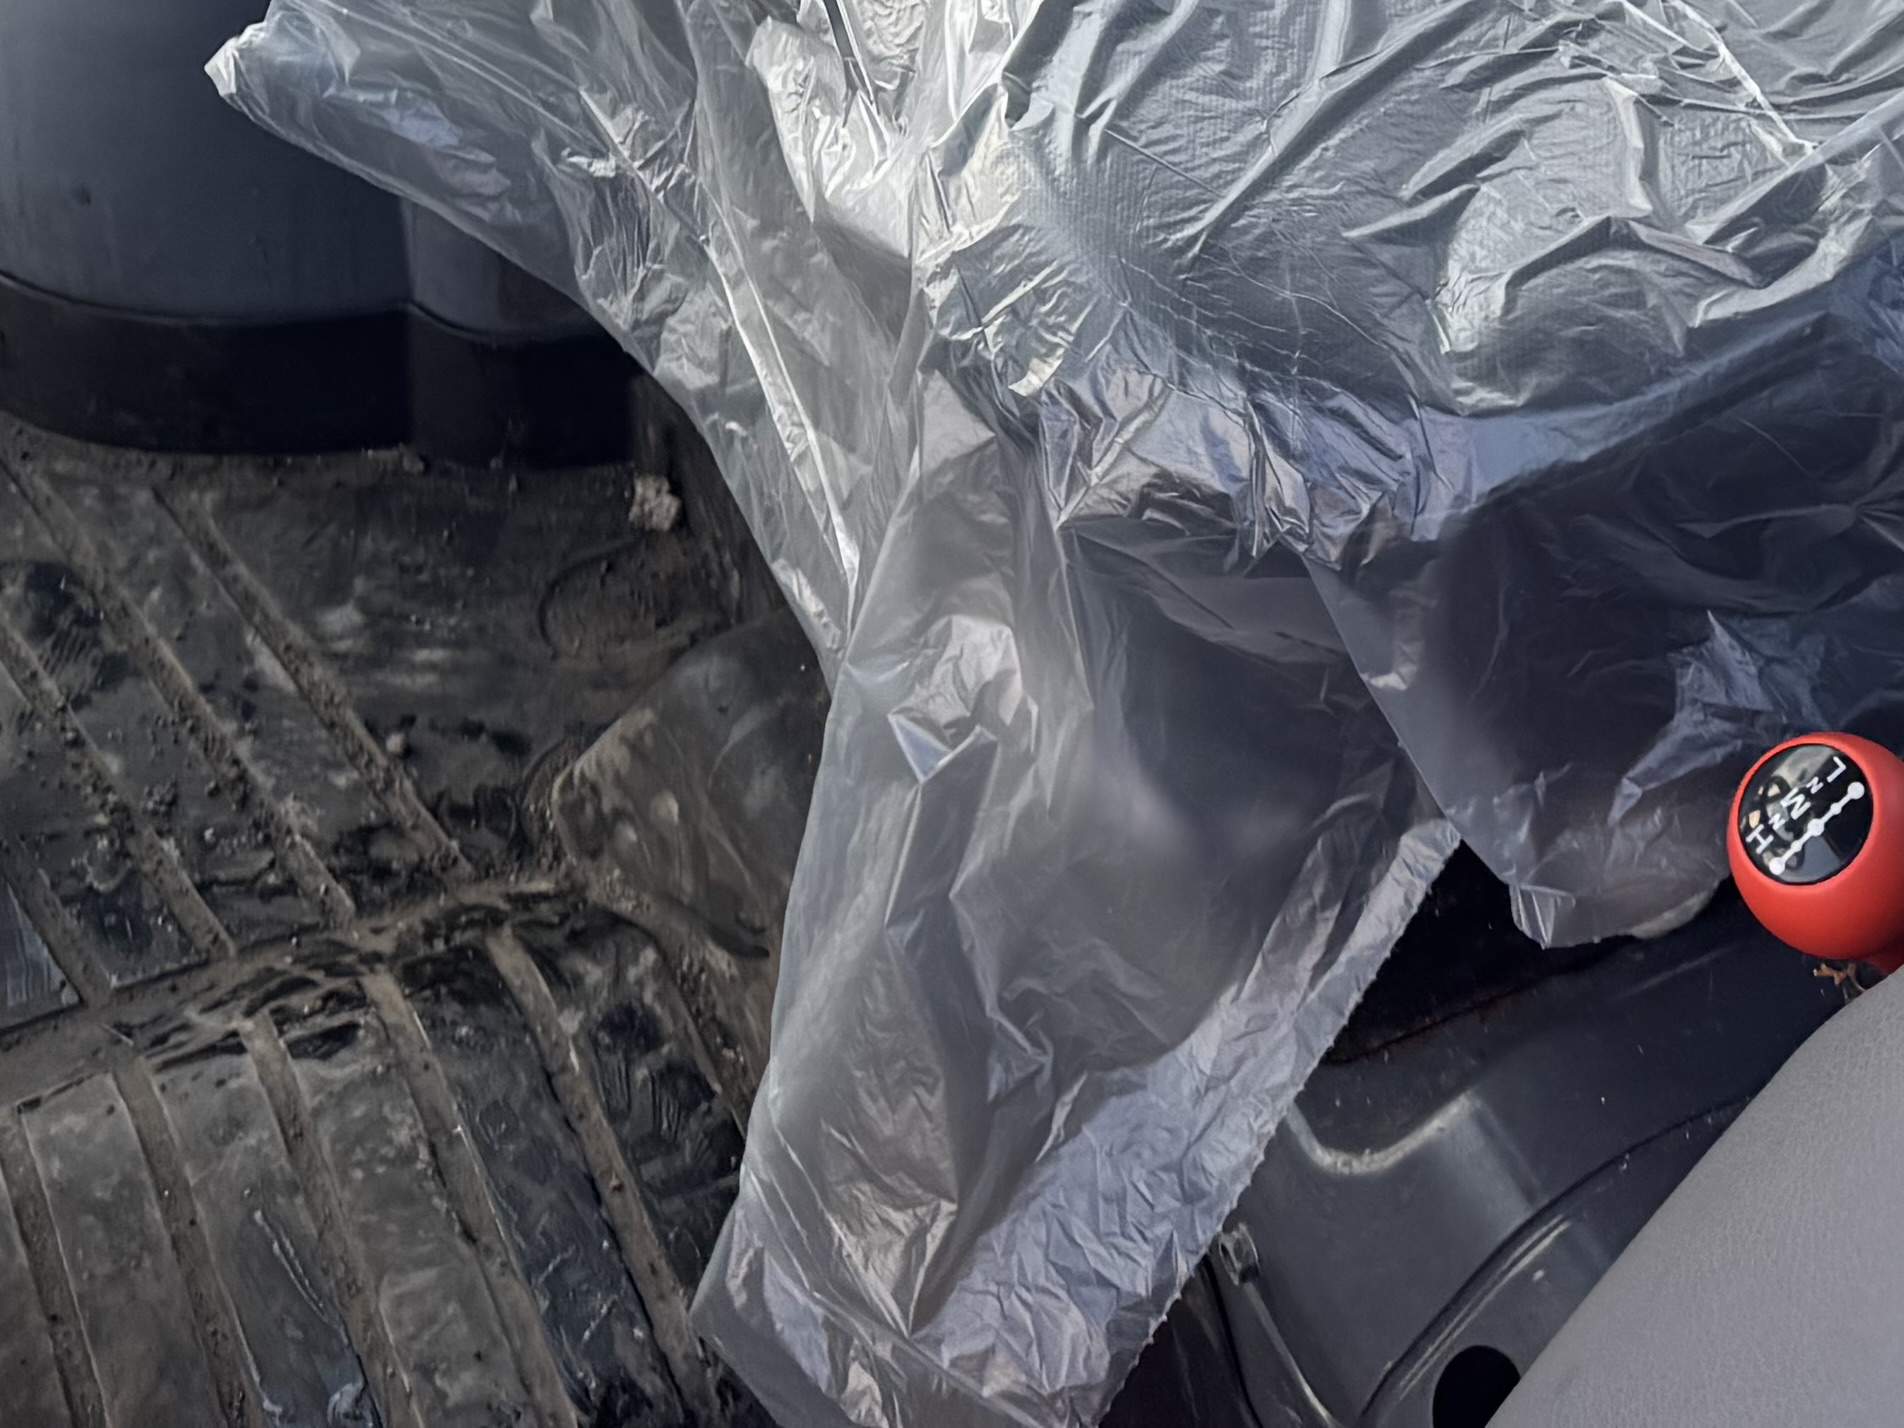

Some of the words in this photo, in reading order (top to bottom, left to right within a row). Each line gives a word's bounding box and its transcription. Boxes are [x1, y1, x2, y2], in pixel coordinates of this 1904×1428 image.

[1826, 756, 1847, 783] L
[1780, 787, 1811, 820] M
[1746, 823, 1774, 854] H
